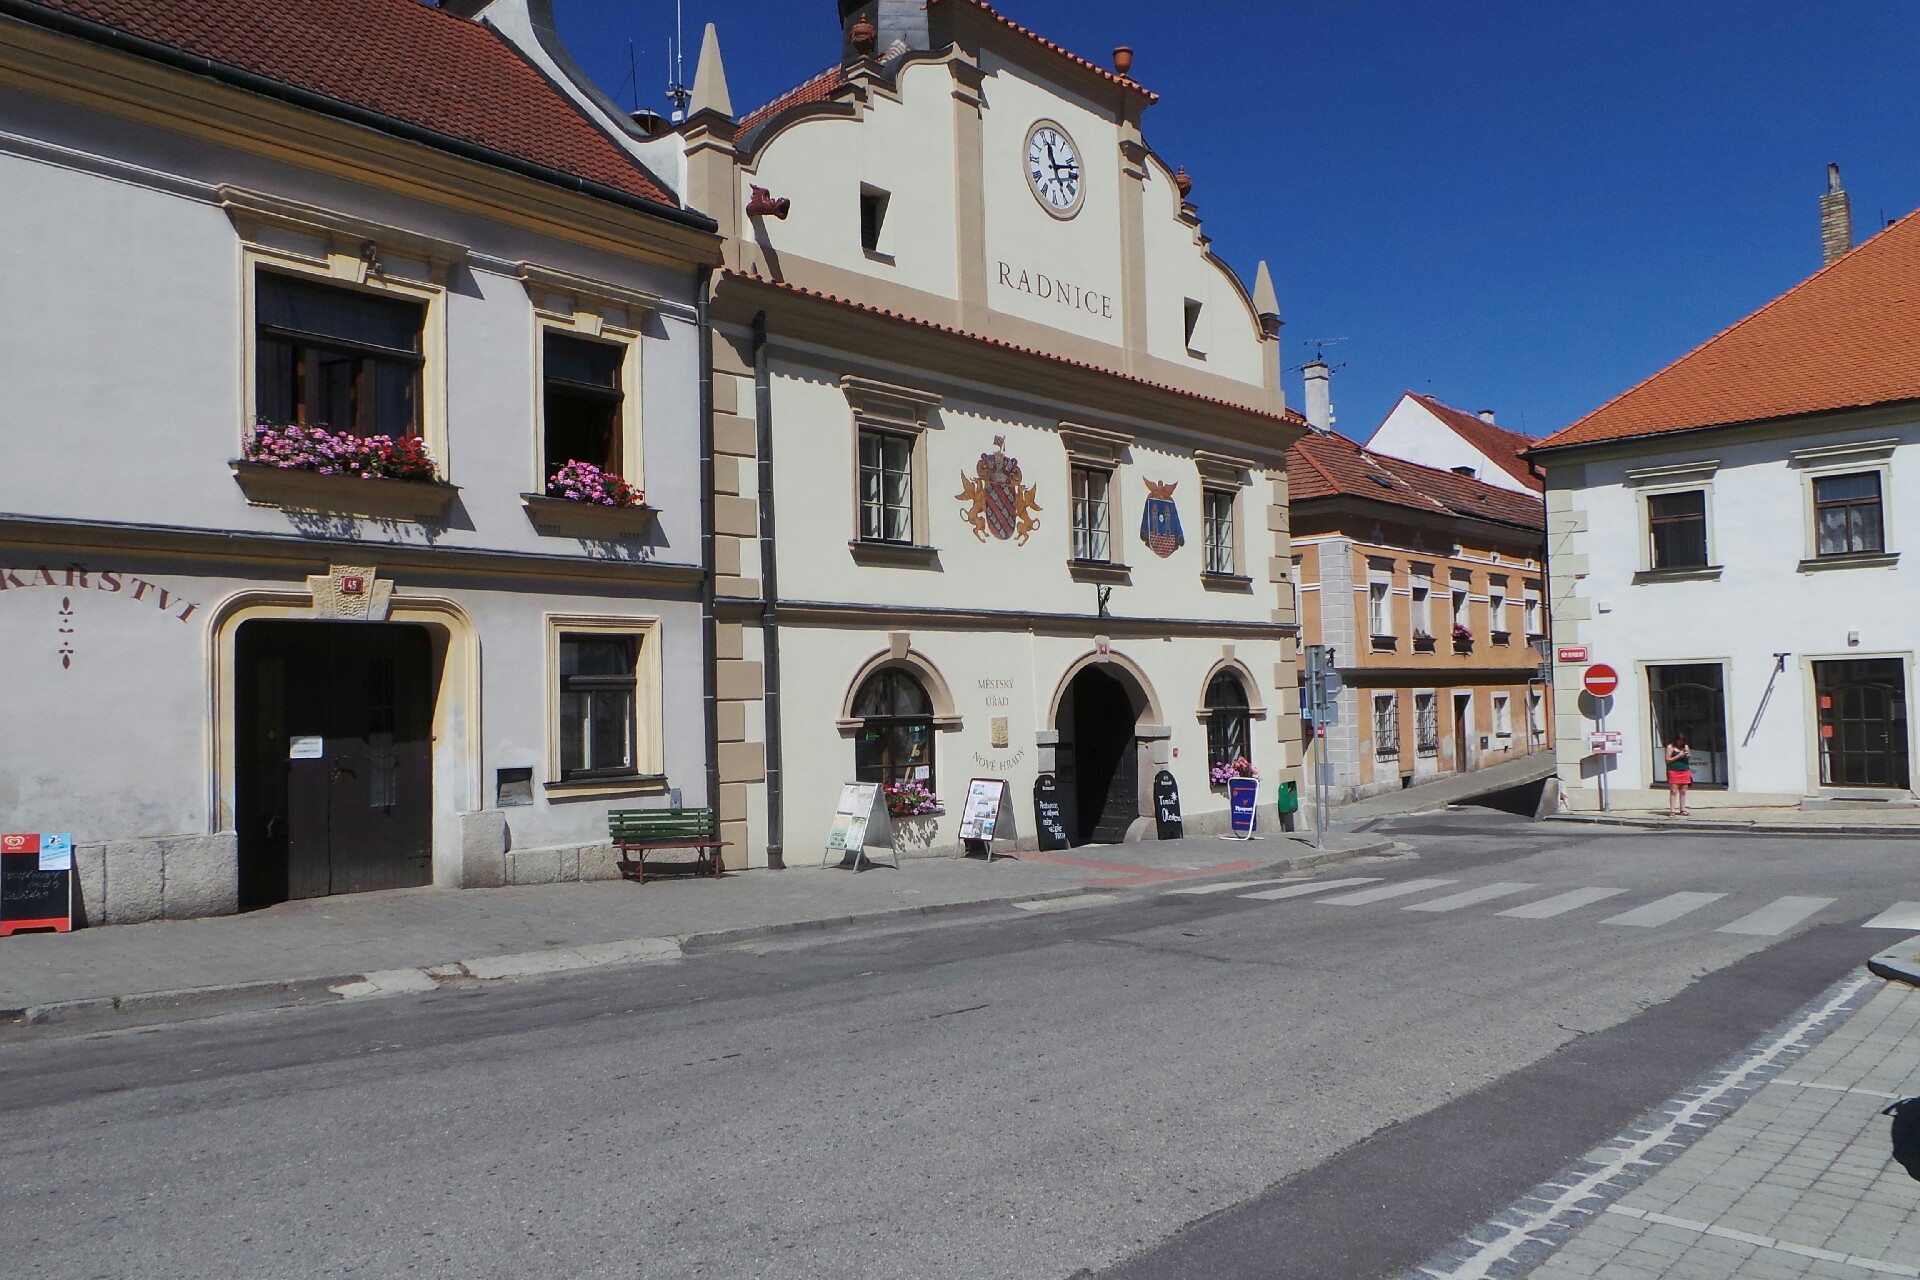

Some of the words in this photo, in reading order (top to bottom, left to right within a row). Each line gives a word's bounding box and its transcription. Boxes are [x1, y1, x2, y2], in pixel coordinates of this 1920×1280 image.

[998, 261, 1113, 319] RADNICE
[347, 580, 357, 590] 45
[977, 677, 1014, 689] MĚSTSKÝ
[985, 694, 1009, 707] ÚŘAD
[972, 751, 996, 771] NOVÉ
[999, 747, 1025, 771] HRADY
